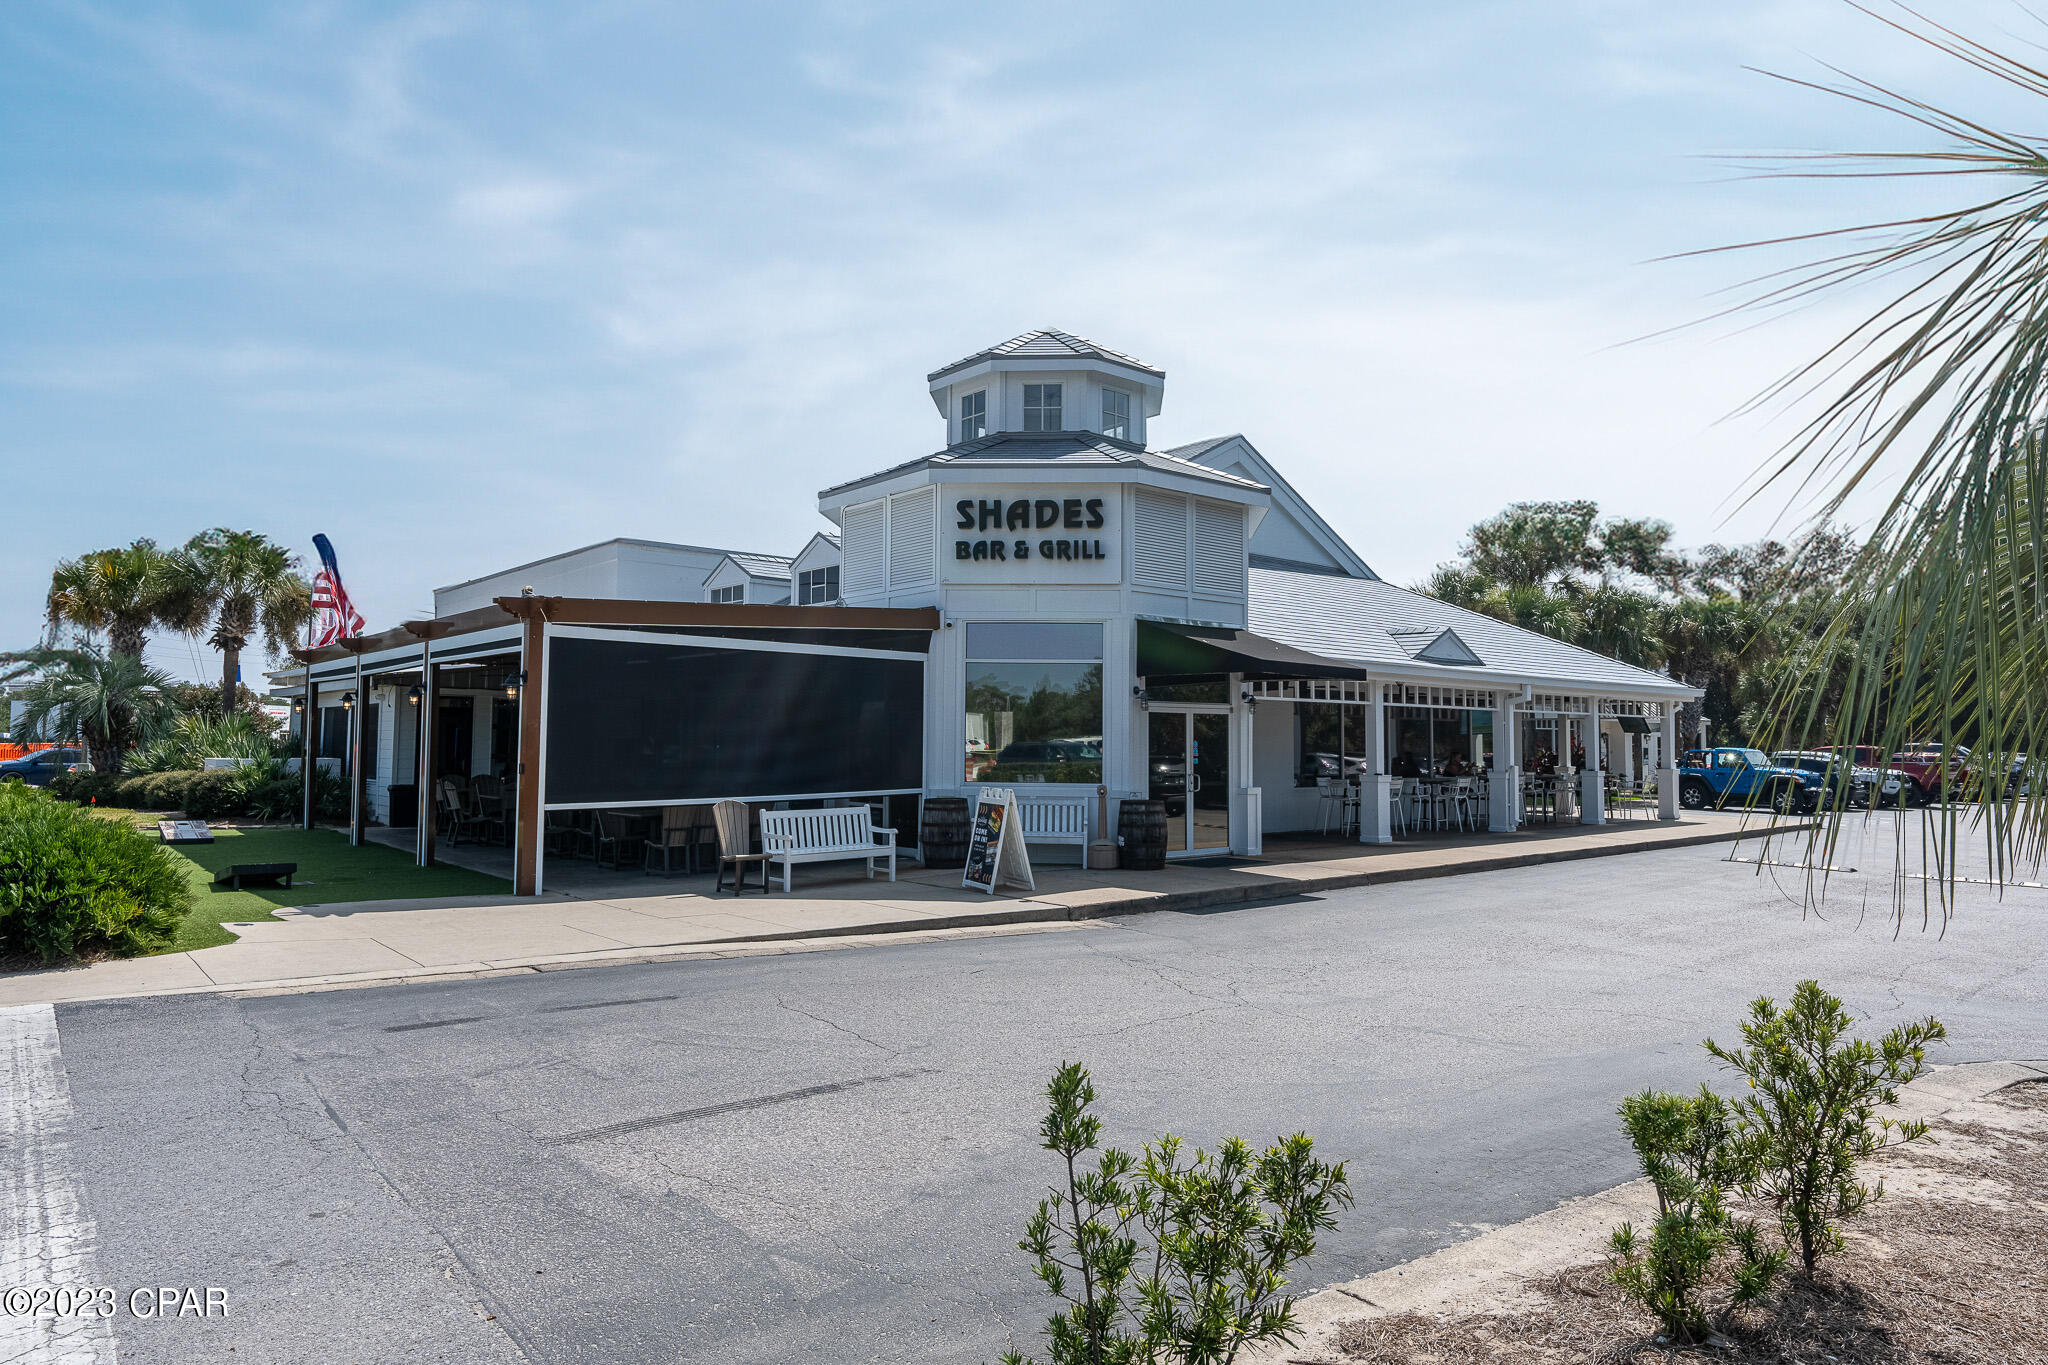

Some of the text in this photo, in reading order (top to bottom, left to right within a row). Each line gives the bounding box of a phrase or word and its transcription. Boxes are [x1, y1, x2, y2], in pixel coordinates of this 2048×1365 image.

[956, 499, 1104, 532] SHADES
[955, 540, 1106, 562] BAR & GRILL
